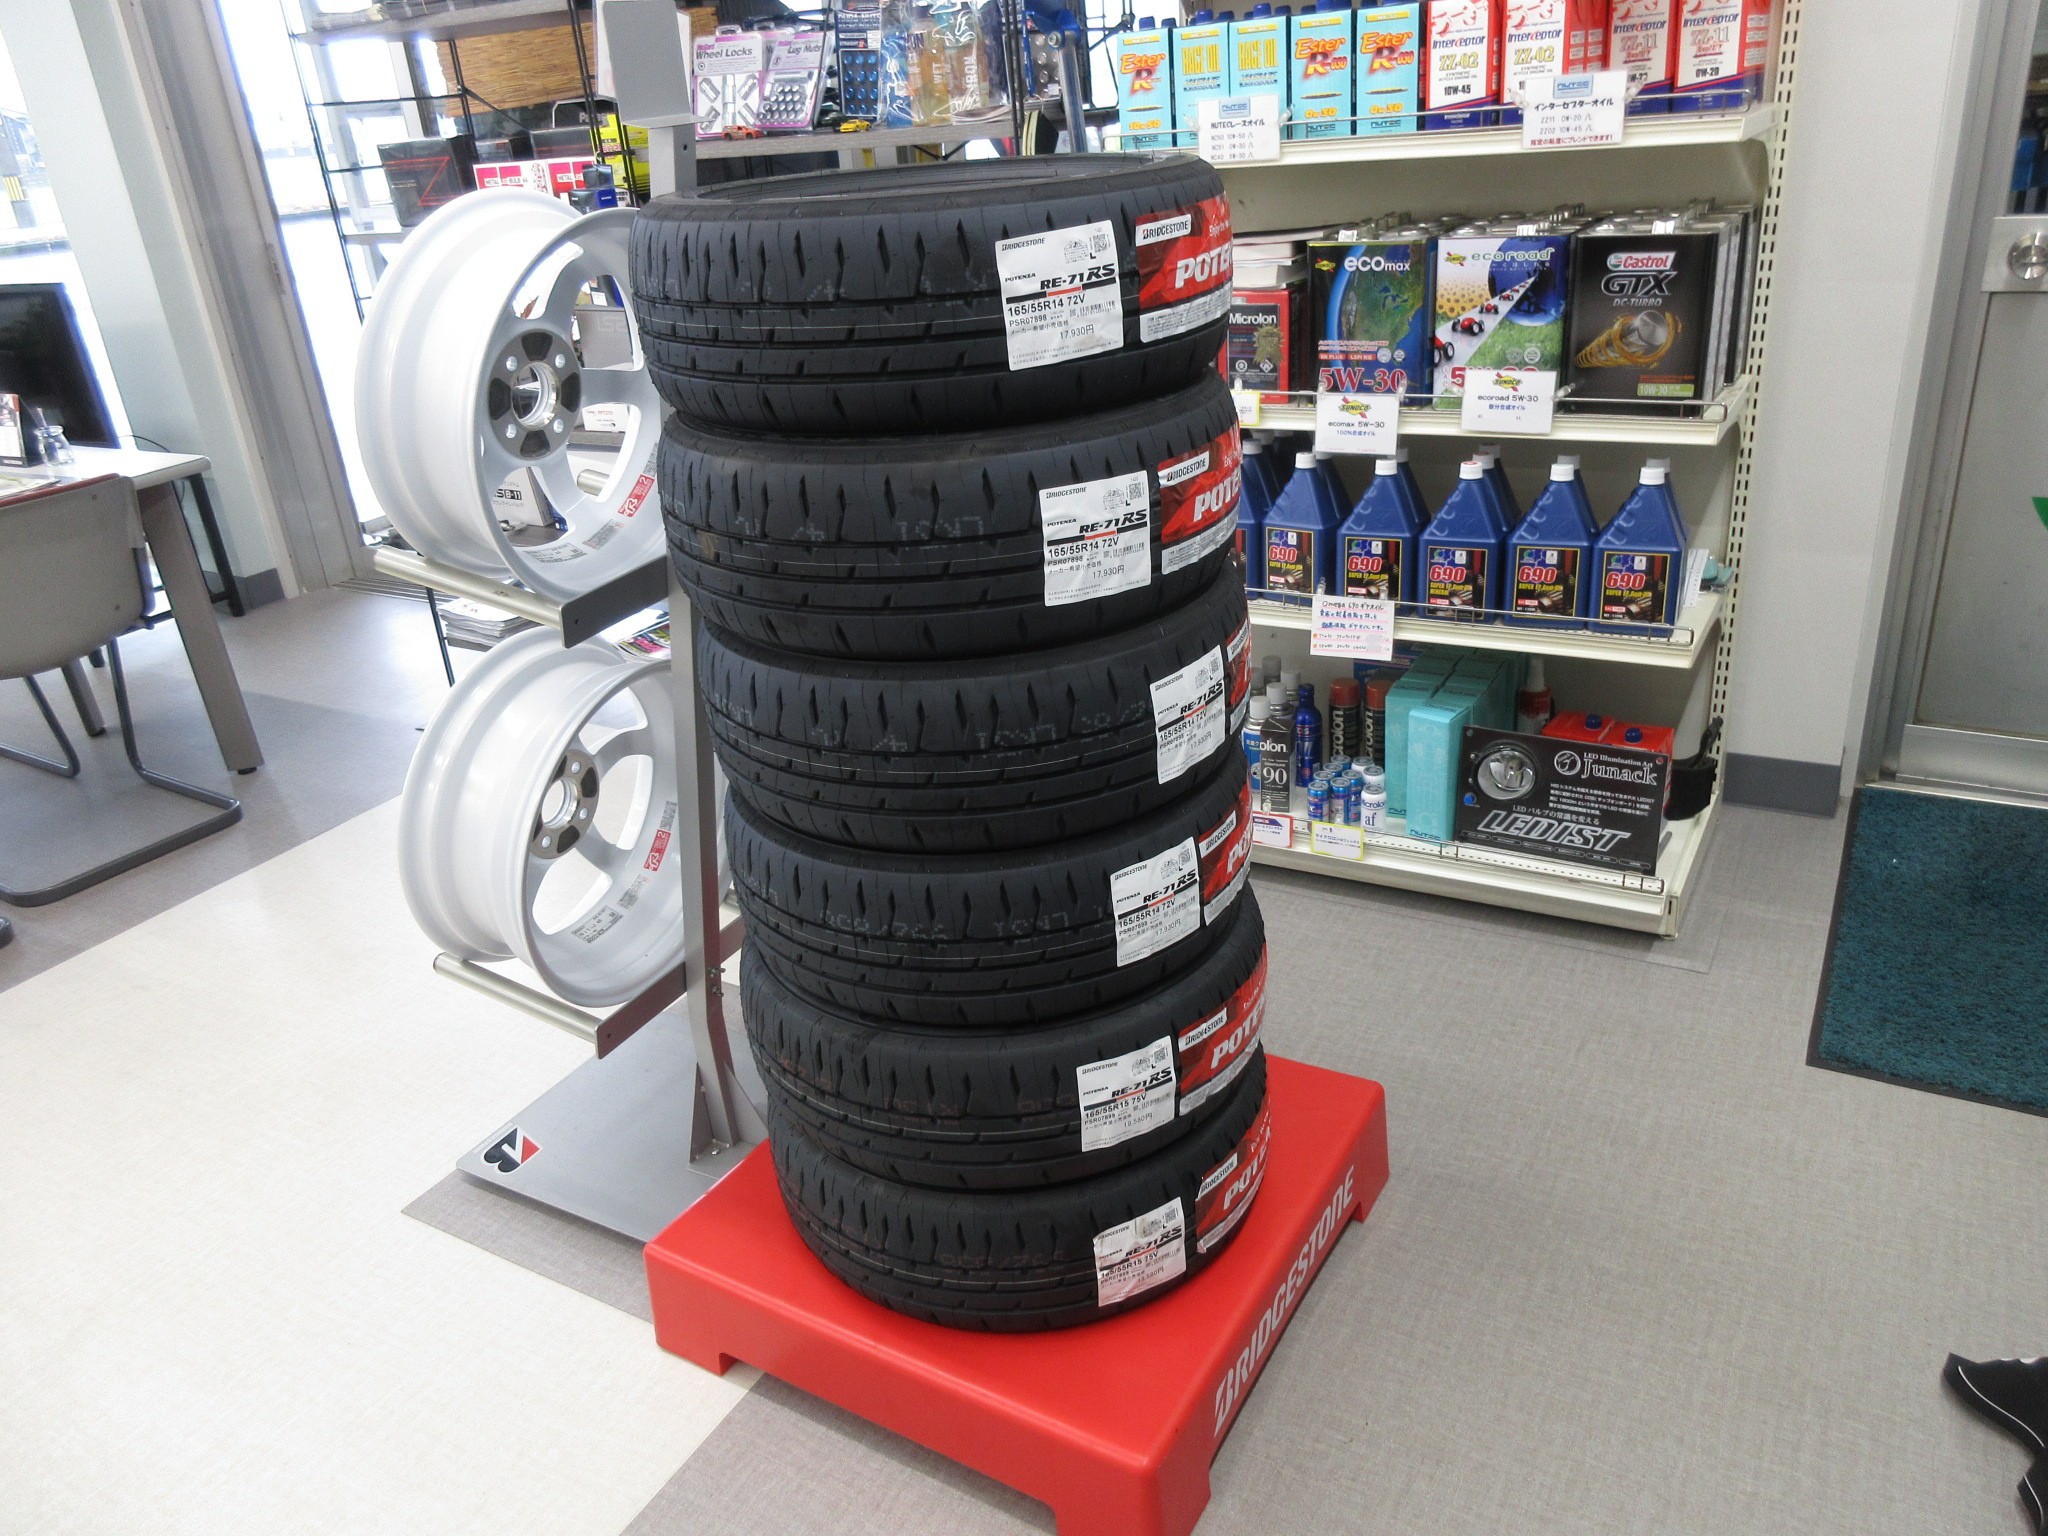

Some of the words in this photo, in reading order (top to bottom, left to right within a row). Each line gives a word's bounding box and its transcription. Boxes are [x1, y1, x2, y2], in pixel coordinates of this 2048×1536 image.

[1613, 20, 1667, 34] Interceptor
[1683, 13, 1739, 27] Interceptor
[1361, 31, 1413, 54] Ester
[1432, 35, 1486, 49] Interceptor
[1508, 29, 1563, 43] Interceptor
[696, 48, 723, 60] Wheel
[725, 47, 753, 58] Locks
[787, 45, 801, 55] Lug
[803, 44, 821, 53] Nuts
[1295, 38, 1346, 59] Ester
[1514, 46, 1554, 66] ZZ-02
[1120, 53, 1166, 74] Ester
[1439, 52, 1478, 71] ZZ-02
[1695, 67, 1719, 78] 0W-20
[1444, 84, 1471, 96] 10W-45
[1142, 220, 1189, 239] BRIDGESTONE
[1002, 237, 1045, 251] BRIDGESTONE
[1471, 247, 1555, 261] ecoroad
[1623, 255, 1669, 269] Castrol
[1344, 256, 1410, 271] ecomax
[1004, 273, 1036, 282] POTENZA
[1040, 263, 1116, 290] RE-71RS
[1601, 272, 1677, 296] GTX
[1008, 299, 1064, 317] 165/55R14
[1067, 294, 1086, 306] 72V
[1613, 298, 1662, 307] DC-TURBO
[1009, 314, 1047, 327] PSR07898
[1229, 313, 1277, 325] Microlon
[1010, 321, 1069, 336] メーカー希望小売価格
[1059, 324, 1095, 340] 17,930円
[1320, 367, 1407, 392] 5W-30
[1167, 458, 1206, 482] BRIDGESTONE
[1046, 486, 1087, 499] BRIDGESTONE
[1047, 518, 1077, 527] POTENZA
[1079, 509, 1147, 533] RE-71RS
[1049, 541, 1099, 558] 165/55R14
[1102, 536, 1119, 549] 72V
[1269, 545, 1297, 562] 690
[1047, 555, 1084, 566] PSR07898
[1049, 560, 1102, 574] メーカー希望小売価格
[1348, 555, 1382, 572] 690
[1093, 564, 1125, 579] 17,930円
[1430, 565, 1466, 583] 690
[1518, 565, 1557, 583] 690
[1606, 571, 1646, 590] 690
[1158, 703, 1179, 716] POTENZA
[1180, 681, 1223, 715] RE-71RS
[1160, 718, 1194, 742] 165/55R14
[1196, 711, 1207, 723] 72V
[1584, 752, 1599, 760] LED
[1600, 753, 1641, 766] Illumination
[1263, 767, 1288, 785] 90
[1581, 758, 1657, 785] Junack
[1513, 804, 1527, 813] LED
[1365, 812, 1377, 826] af
[1206, 818, 1235, 850] BRIDGESTONE
[1477, 809, 1632, 852] LEDIST
[1115, 864, 1147, 880] BRIDGESTONE
[1116, 892, 1141, 903] POTENZA
[1143, 869, 1196, 903] RE-71RS
[1119, 907, 1160, 928] 165/55R14
[1162, 898, 1176, 910] 72V
[1156, 919, 1181, 936] 17,930円
[1185, 1015, 1224, 1046] BRIDGESTONE
[1082, 1062, 1118, 1074] BRIDGESTONE
[1083, 1086, 1109, 1096] POTENZA
[1111, 1067, 1172, 1098] RE-71RS
[1085, 1101, 1129, 1119] 165/55R15
[1132, 1093, 1147, 1105] 75V
[1202, 1160, 1234, 1193] BRIDGESTONE
[1125, 1225, 1182, 1257] RE-71RS
[1101, 1260, 1143, 1278] 165/55R15
[1145, 1251, 1159, 1262] 75V
[1213, 1164, 1355, 1438] BRIDGESTONE
